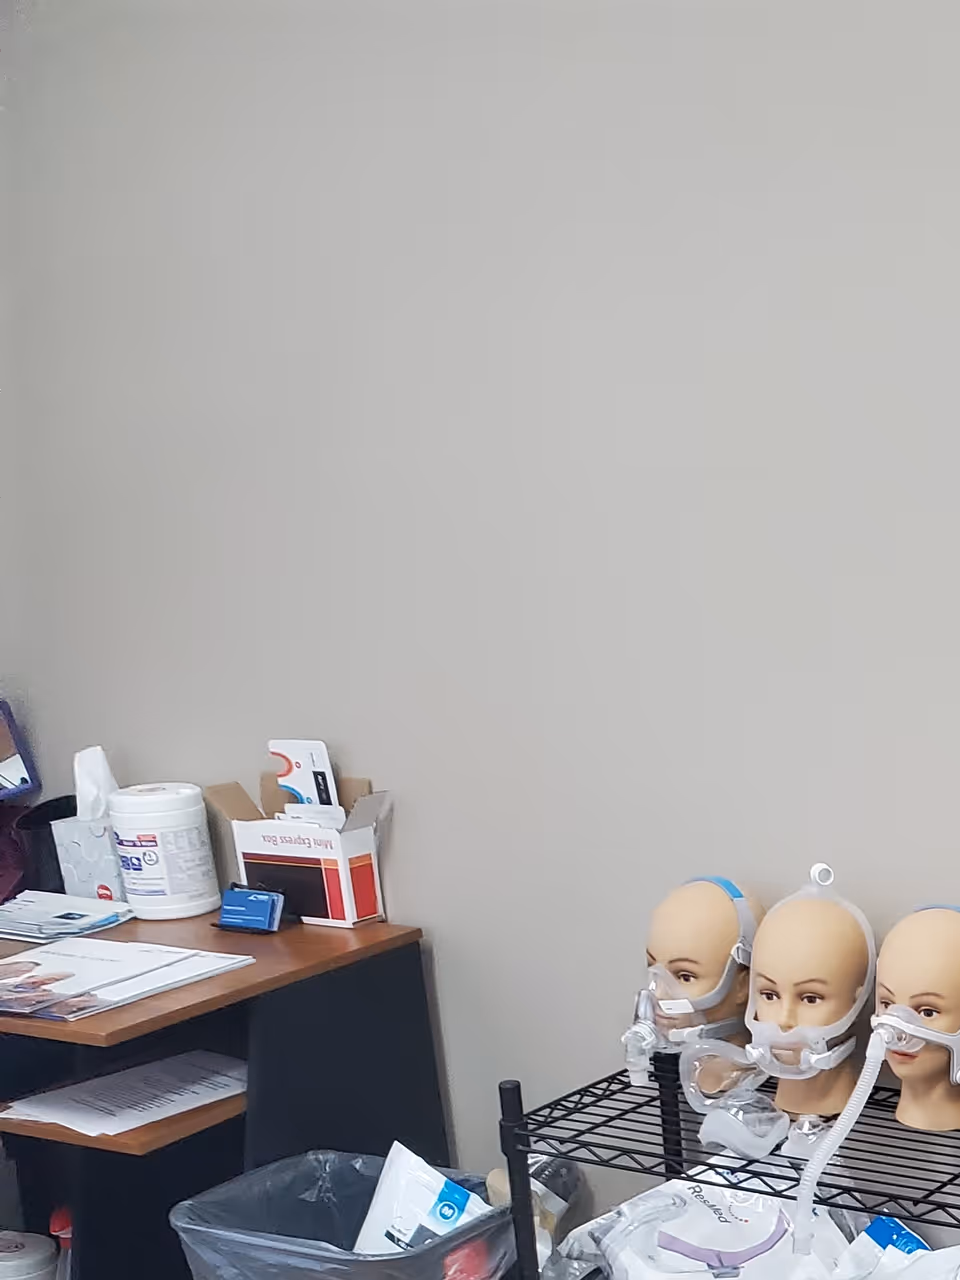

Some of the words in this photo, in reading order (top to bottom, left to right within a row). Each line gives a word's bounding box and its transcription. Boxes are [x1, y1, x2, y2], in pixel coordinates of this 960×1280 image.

[261, 834, 279, 846] Box
[279, 834, 311, 849] Express
[313, 838, 334, 850] Mini
